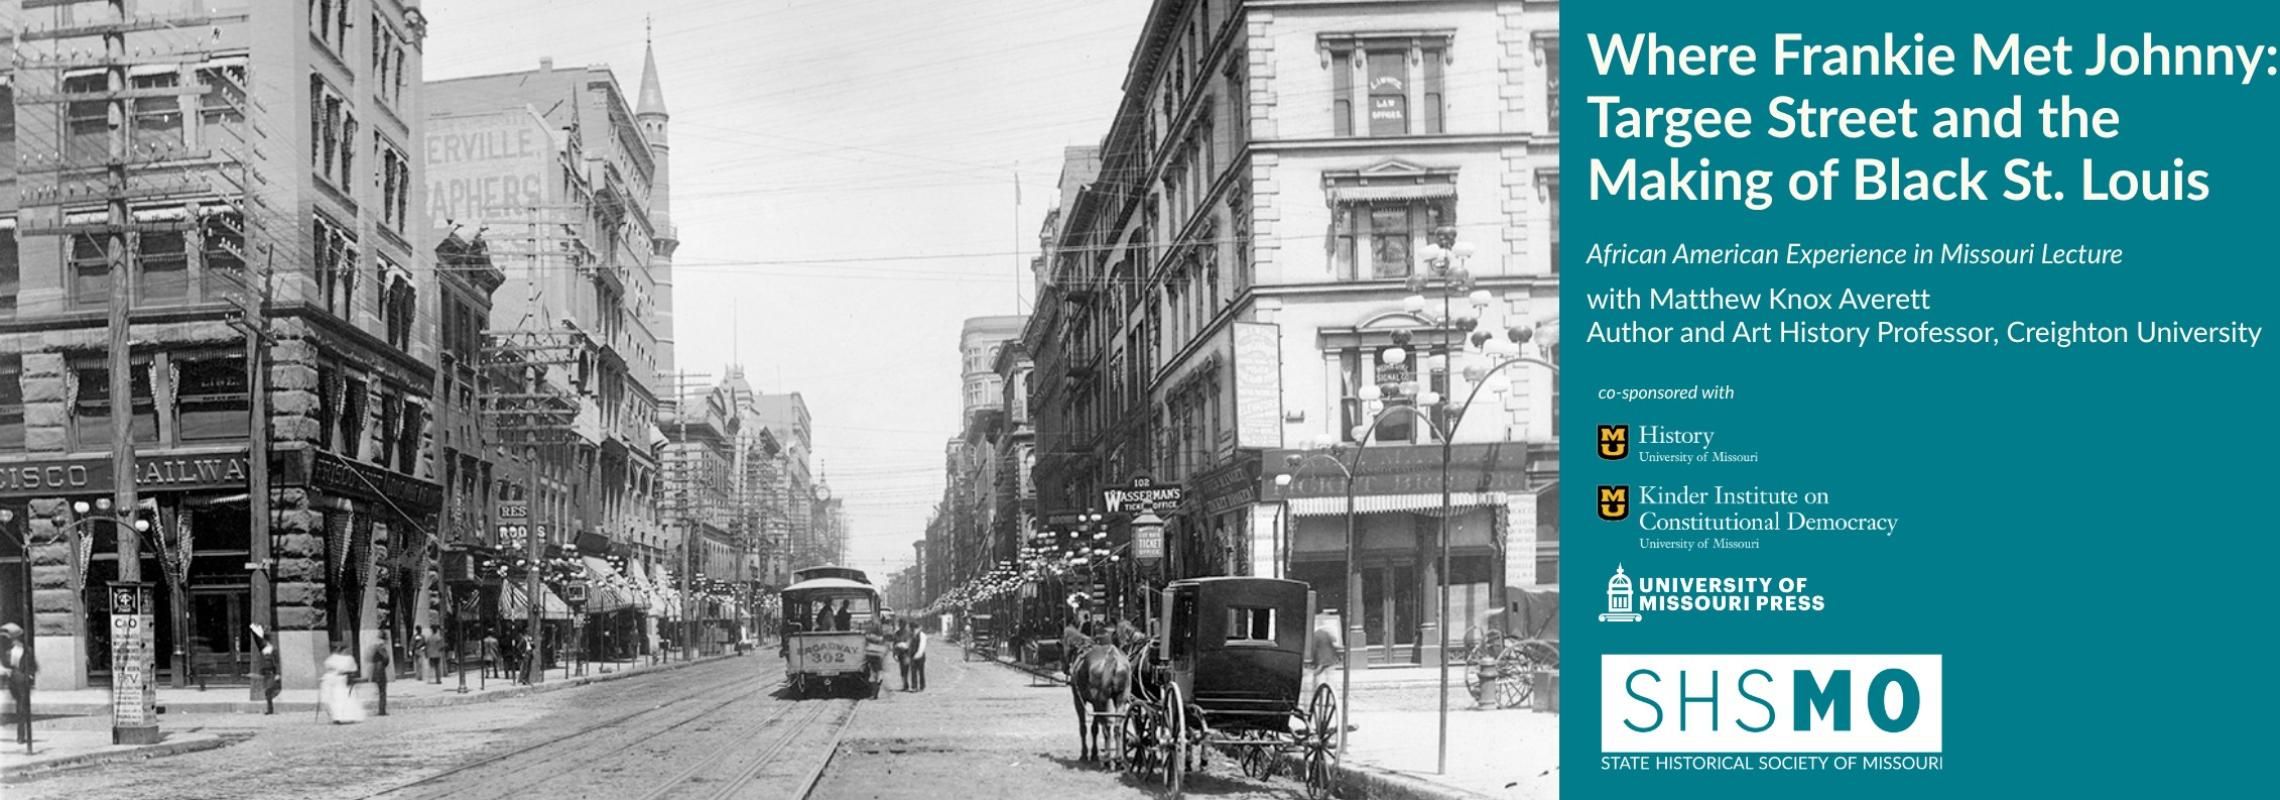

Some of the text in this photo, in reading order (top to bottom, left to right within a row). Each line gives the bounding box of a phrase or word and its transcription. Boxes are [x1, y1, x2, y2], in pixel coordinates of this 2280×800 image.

[1134, 478, 1150, 488] 102
[1104, 488, 1181, 512] WASSERMAN'S
[1138, 538, 1161, 549] TICKET
[811, 652, 846, 663] 302
